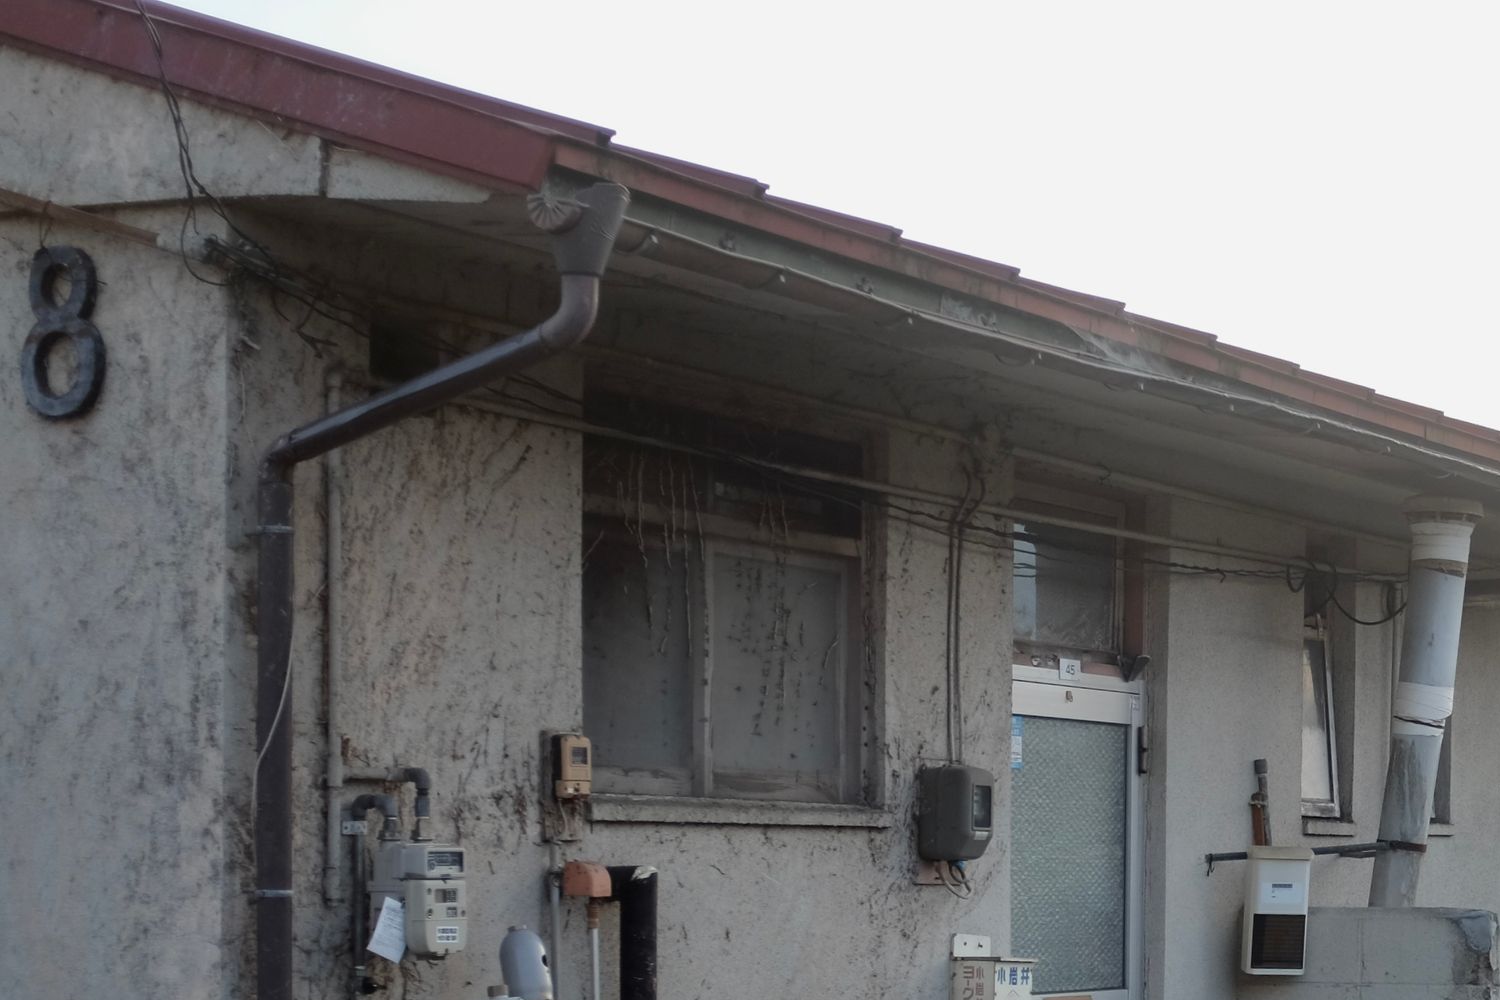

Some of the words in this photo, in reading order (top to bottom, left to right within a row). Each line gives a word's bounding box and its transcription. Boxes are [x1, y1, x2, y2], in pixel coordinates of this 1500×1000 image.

[22, 245, 105, 420] 8
[997, 967, 1030, 986] 小岩井
